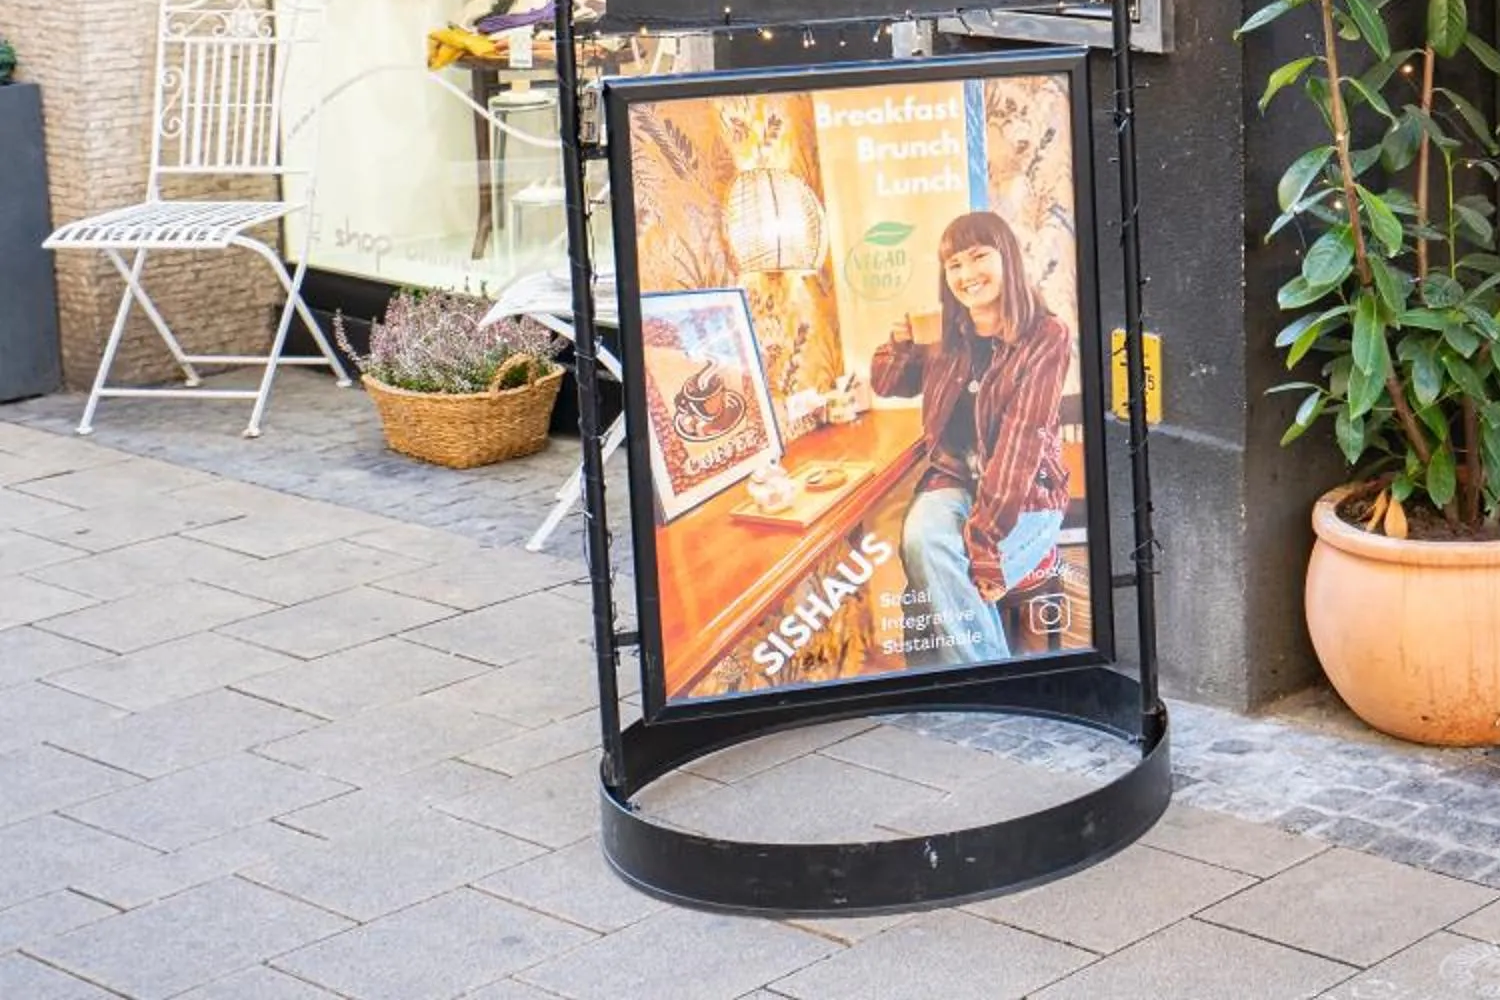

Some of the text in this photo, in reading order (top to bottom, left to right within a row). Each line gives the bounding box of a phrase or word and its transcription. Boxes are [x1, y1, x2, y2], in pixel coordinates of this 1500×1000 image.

[817, 97, 960, 129] Breakfast
[858, 131, 961, 162] Brunch
[878, 166, 962, 196] Lunch
[752, 531, 894, 677] SISHAUS
[880, 588, 932, 608] Social
[882, 609, 977, 632] Integrave
